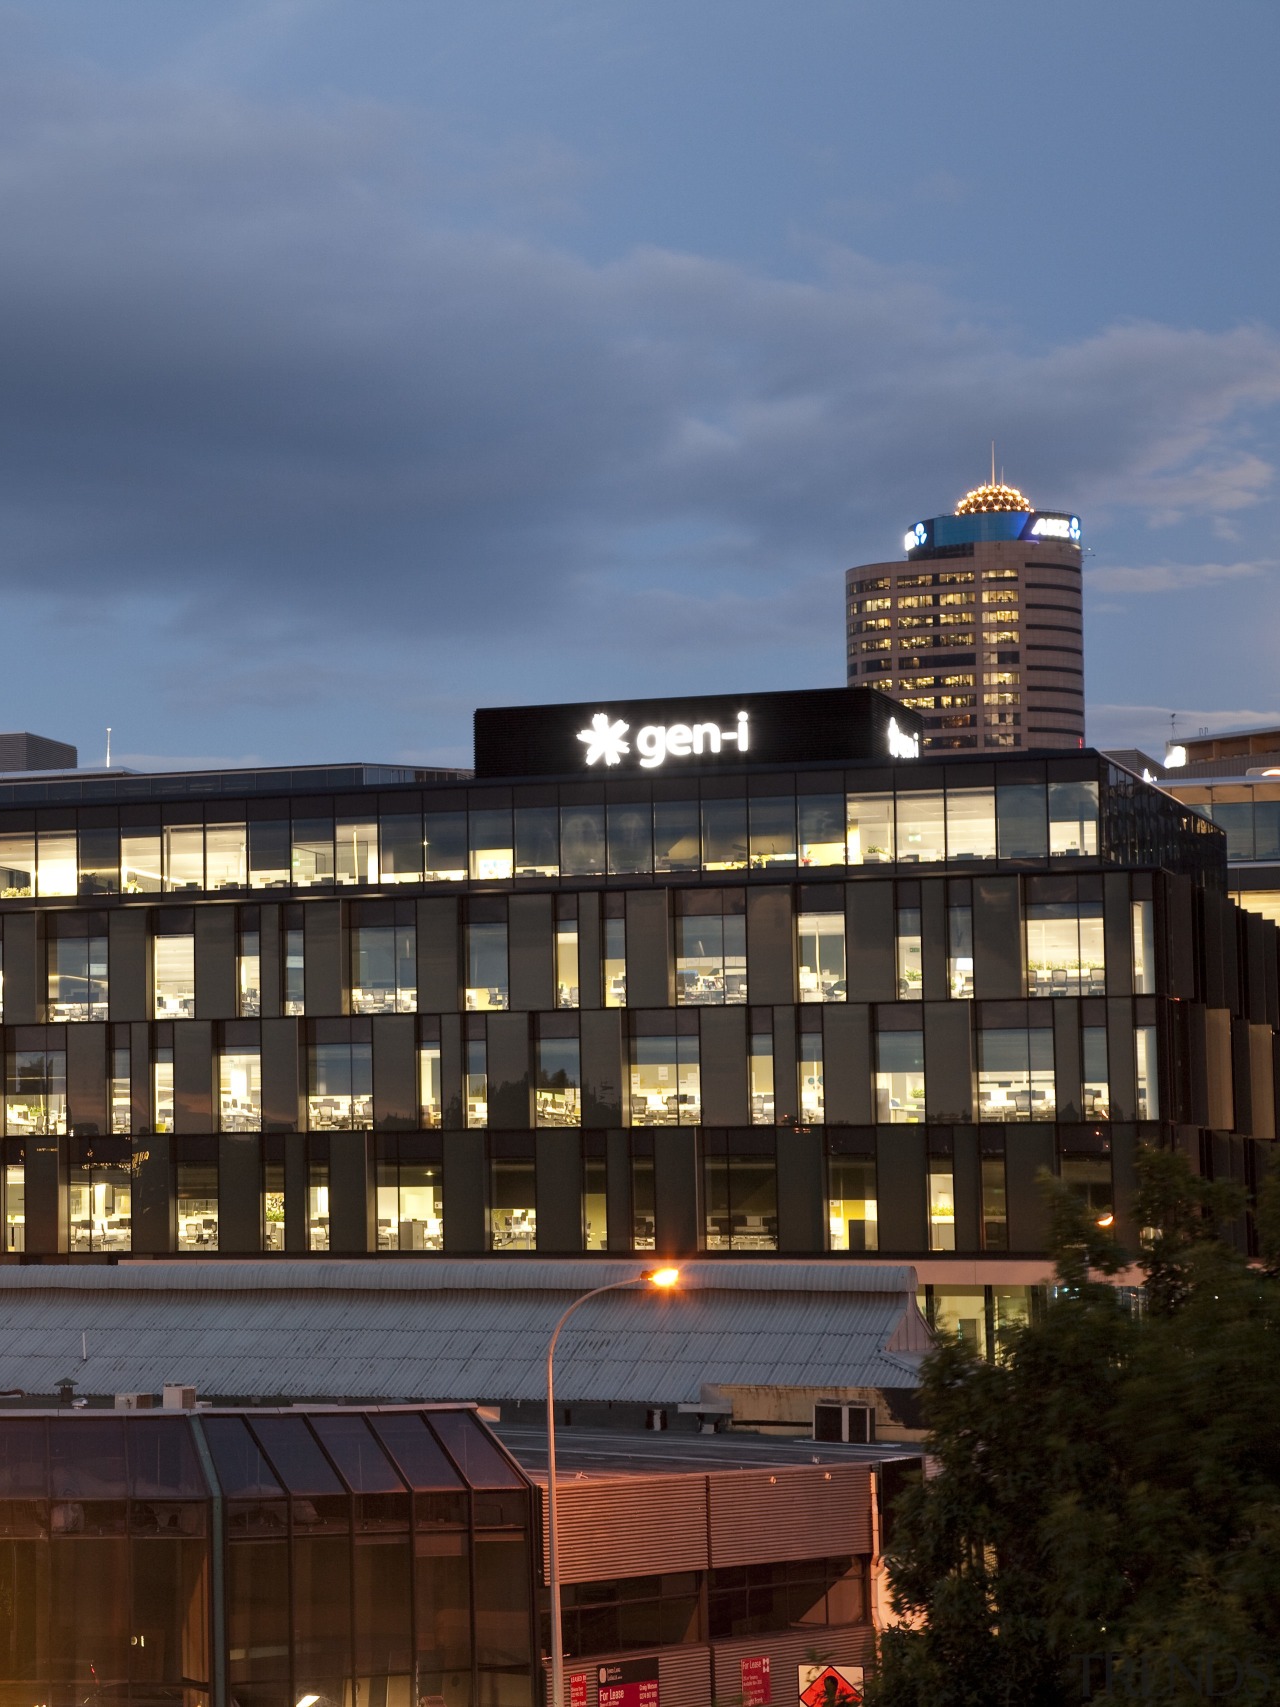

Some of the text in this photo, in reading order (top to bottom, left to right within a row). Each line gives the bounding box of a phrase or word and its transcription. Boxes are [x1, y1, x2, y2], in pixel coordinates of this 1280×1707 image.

[637, 711, 749, 768] gen-i
[599, 1689, 609, 1701] For
[609, 1688, 625, 1700] Lease
